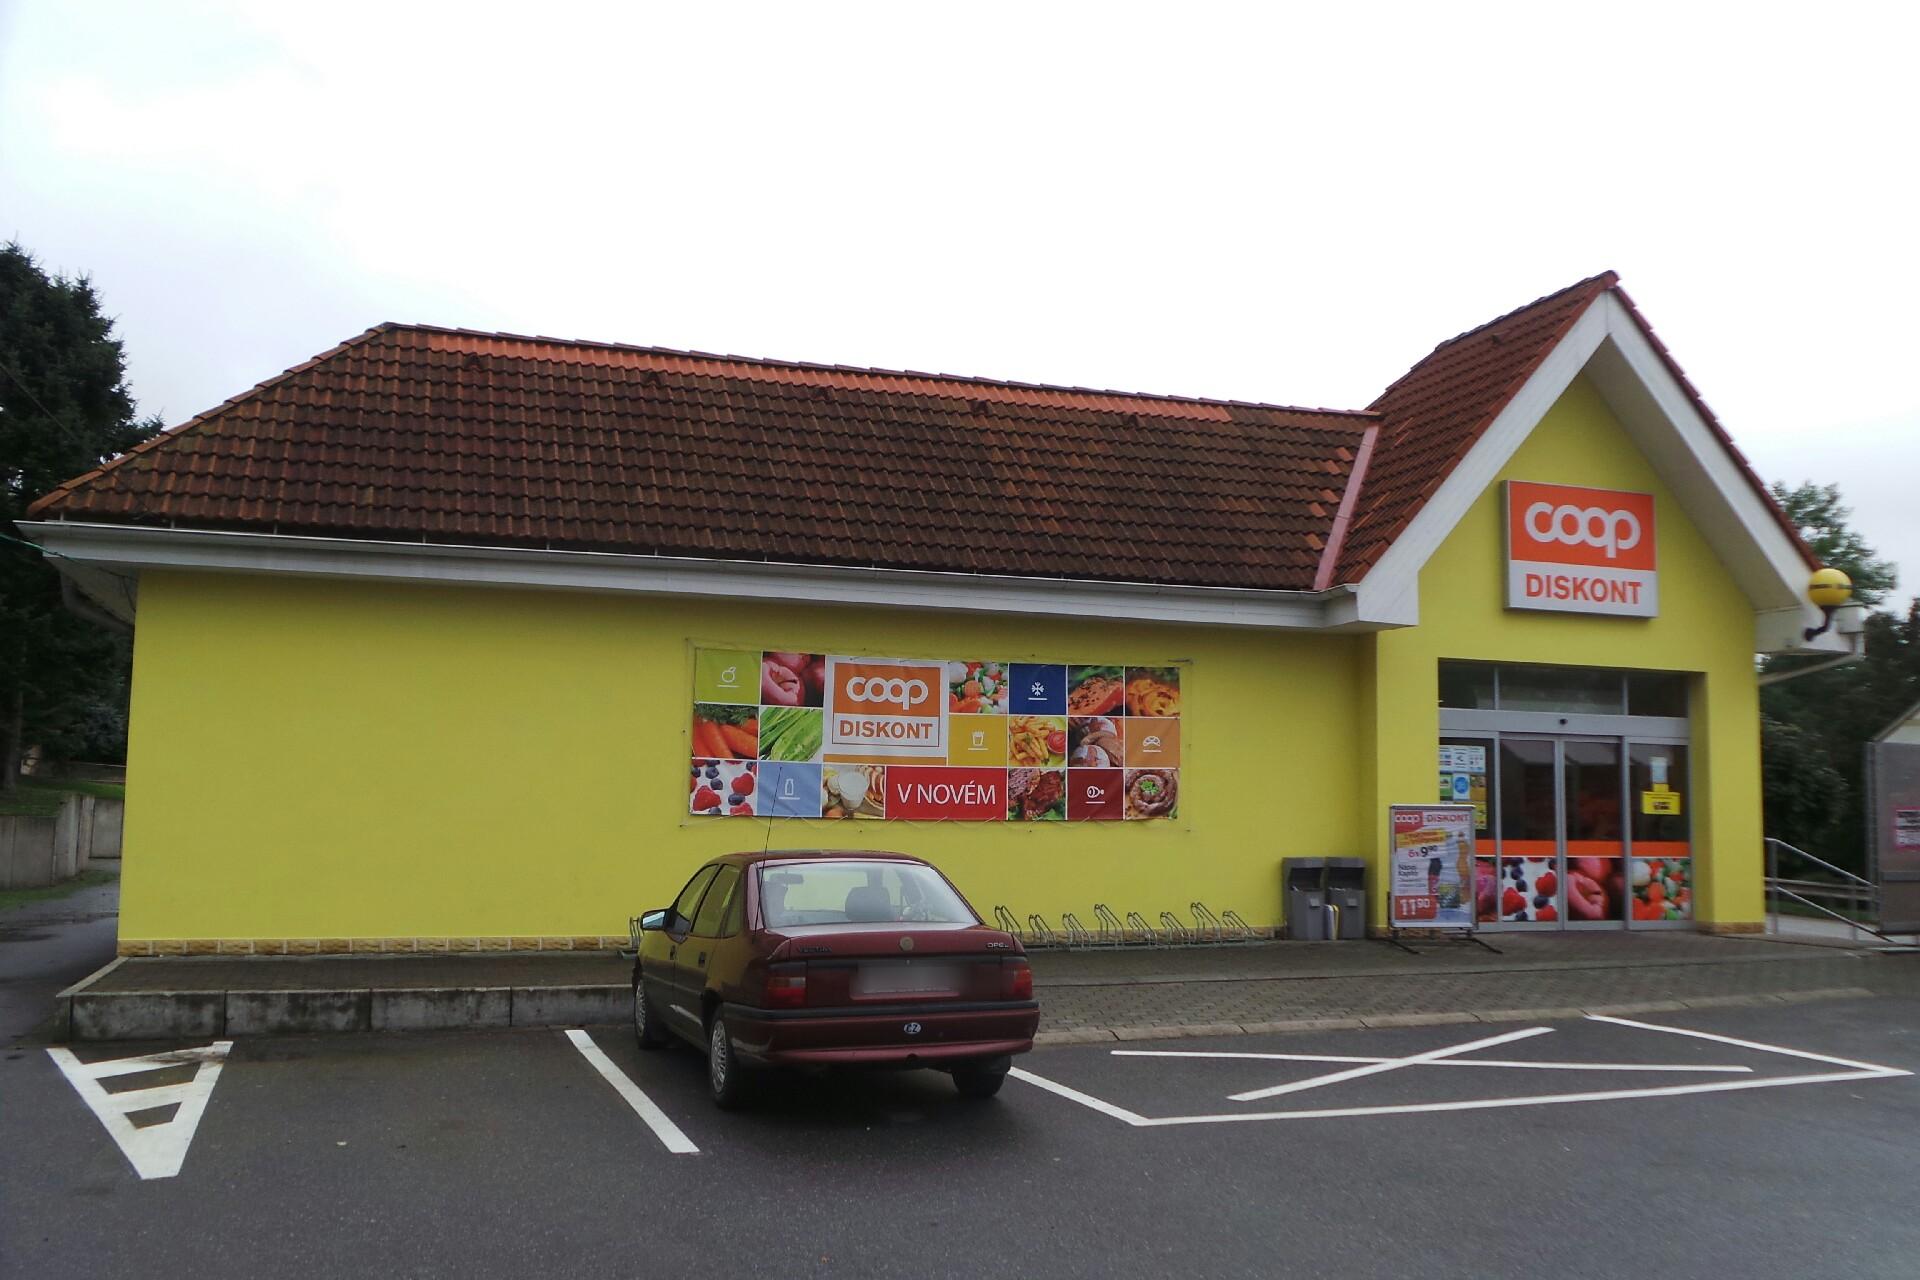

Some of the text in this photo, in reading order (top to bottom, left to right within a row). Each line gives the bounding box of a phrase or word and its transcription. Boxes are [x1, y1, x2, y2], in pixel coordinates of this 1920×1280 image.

[1524, 501, 1642, 559] coop
[1525, 573, 1643, 604] DISKONT
[846, 676, 929, 710] coop
[839, 719, 933, 739] DISKONT
[897, 780, 996, 805] V NOVÉM
[1426, 814, 1469, 823] DISKONT
